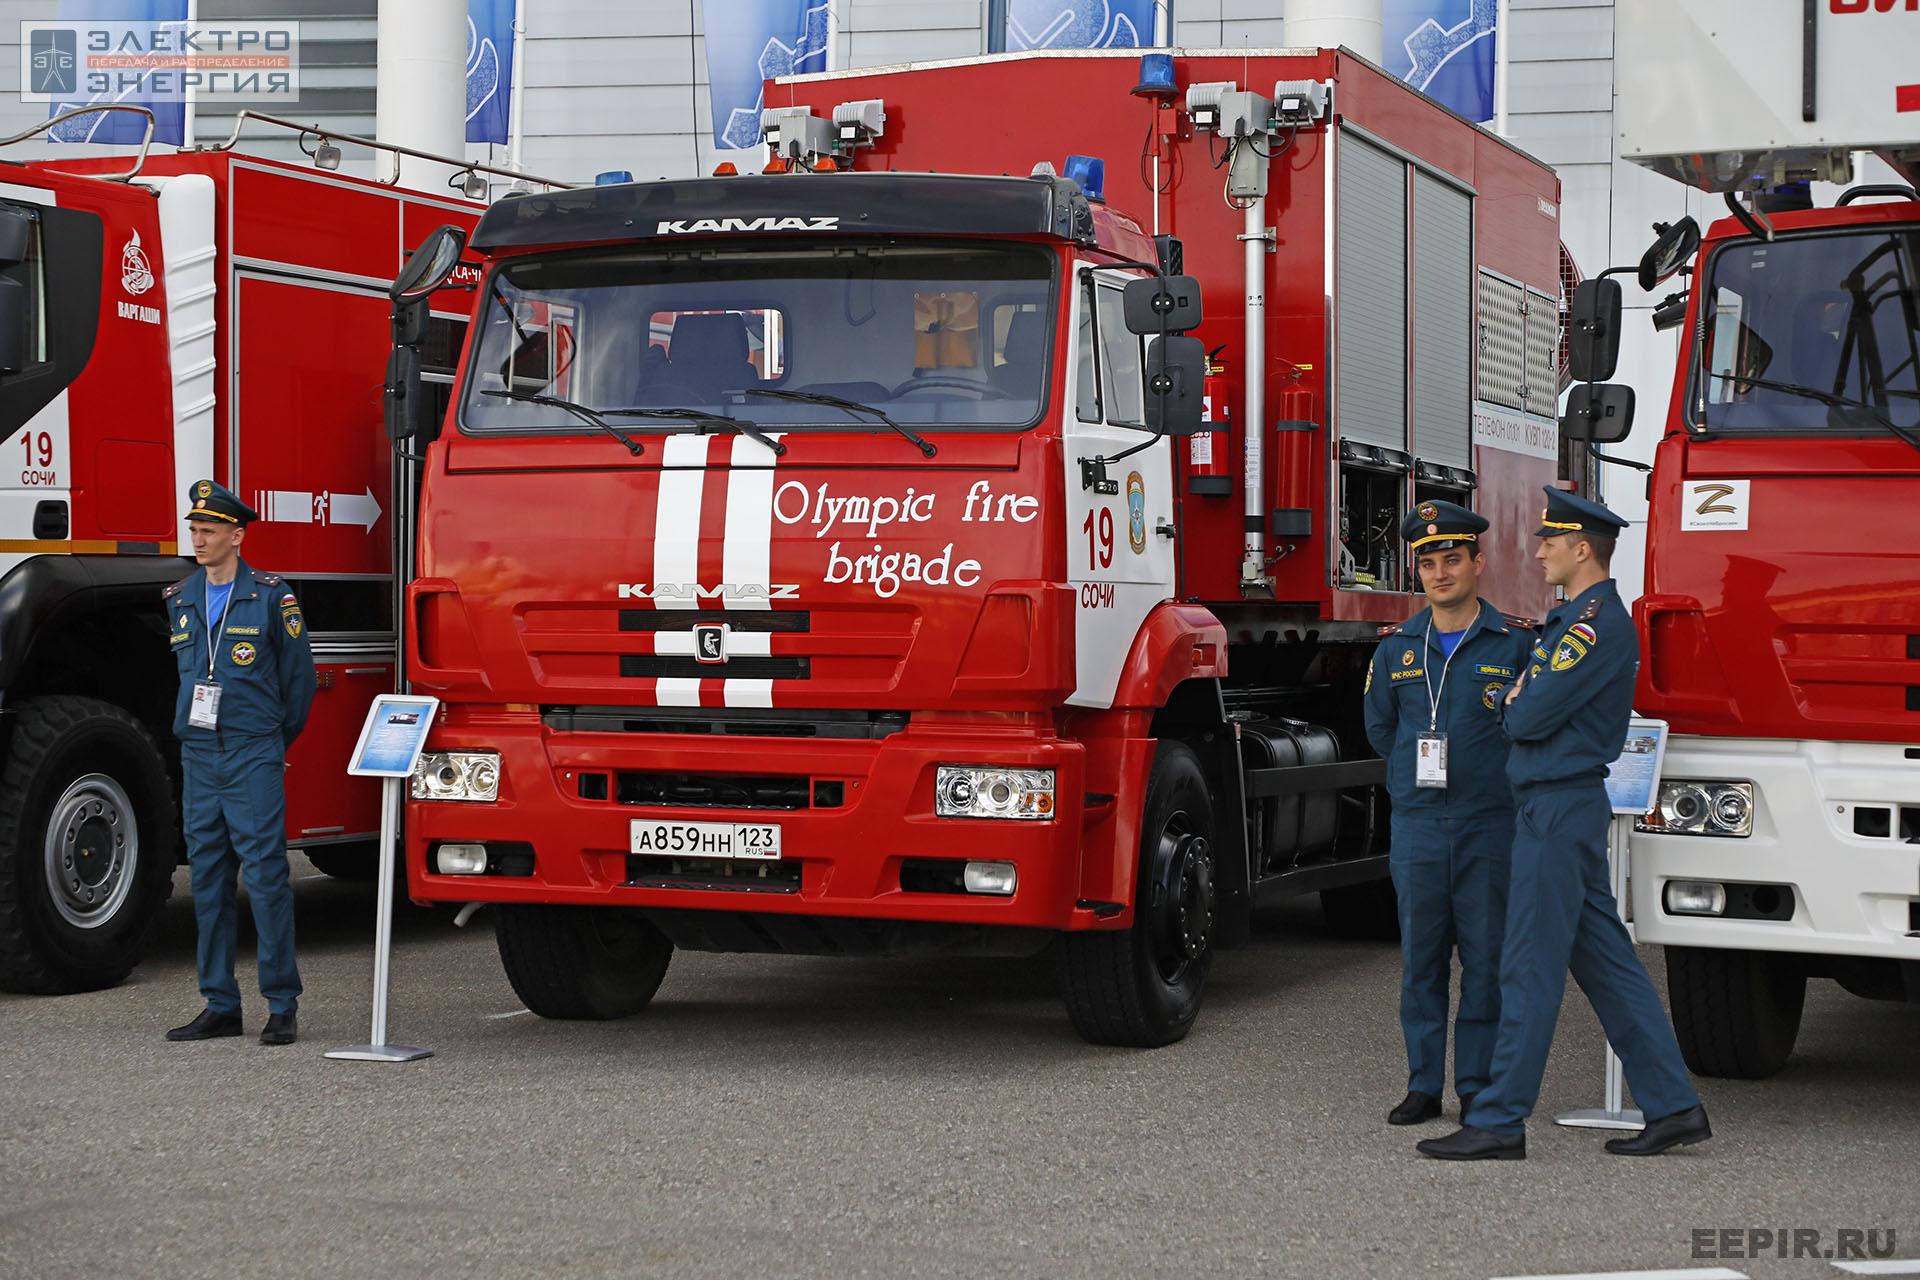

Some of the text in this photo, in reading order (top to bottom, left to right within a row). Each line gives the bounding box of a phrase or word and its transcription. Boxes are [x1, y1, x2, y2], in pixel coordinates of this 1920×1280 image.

[656, 217, 839, 235] KAMAZ
[117, 301, 161, 325] ВАРГАШИ
[20, 431, 52, 467] 19
[21, 470, 56, 486] СОЧИ
[773, 480, 1039, 538] Olympic fire
[1083, 507, 1114, 570] 19
[824, 541, 982, 598] brigade
[618, 583, 800, 599] KAMAZ
[1081, 583, 1115, 609] СОЧИ
[639, 826, 773, 853] А859НН 123
[745, 847, 764, 855] RUS
